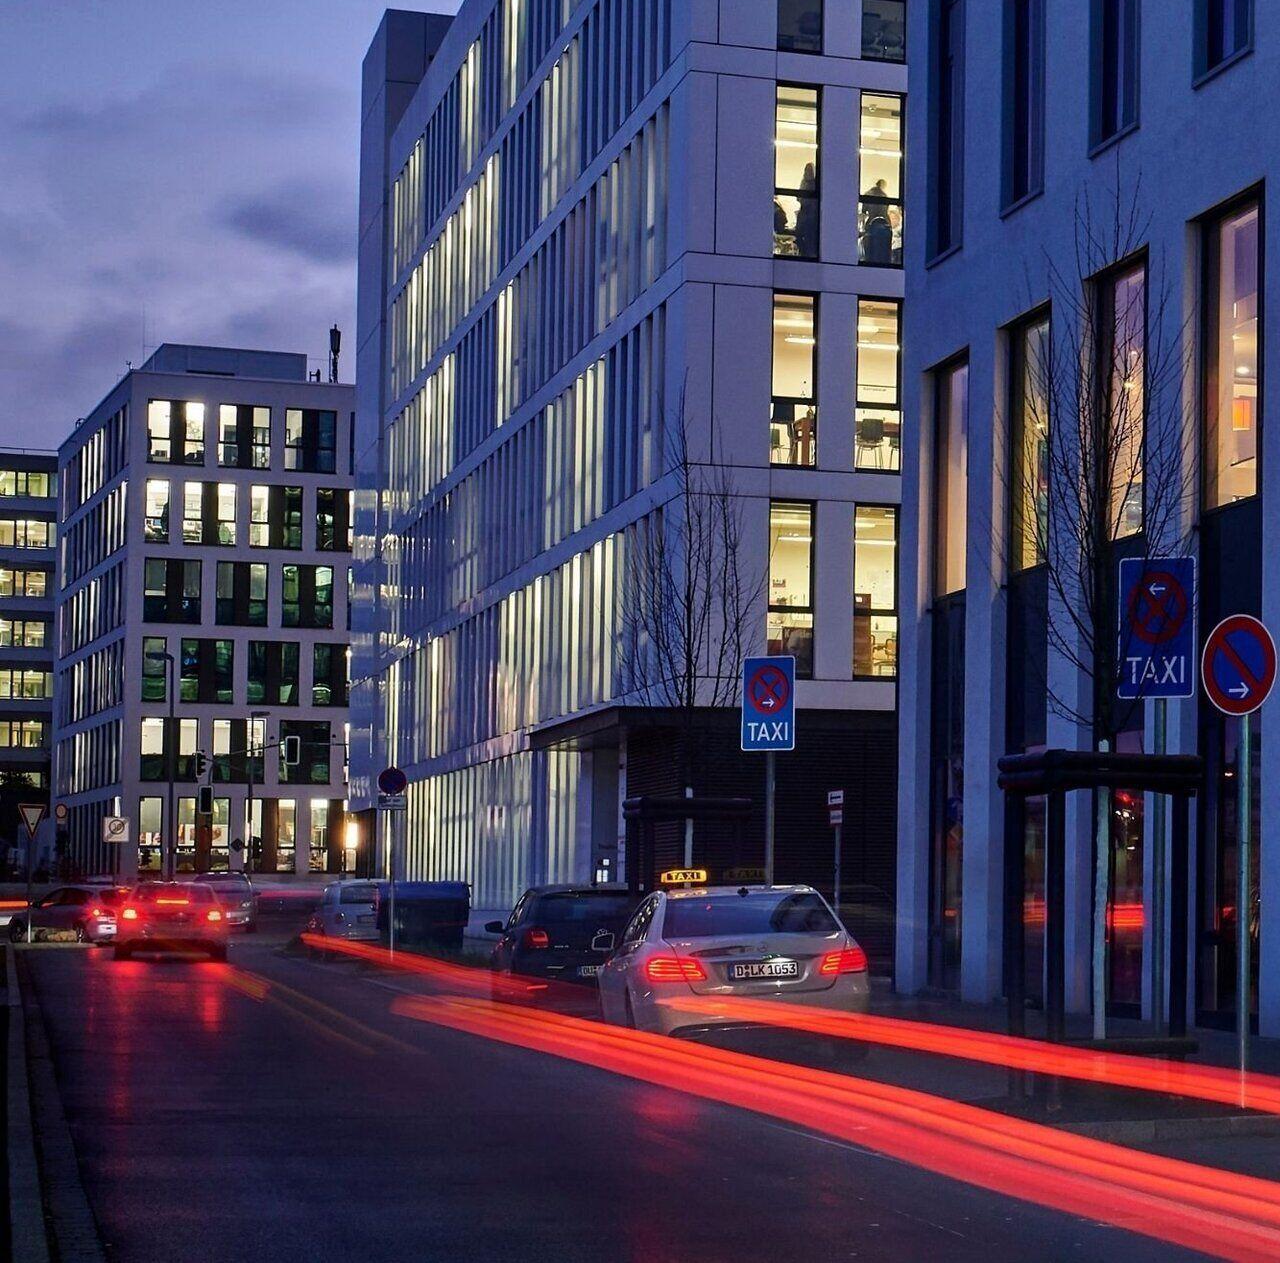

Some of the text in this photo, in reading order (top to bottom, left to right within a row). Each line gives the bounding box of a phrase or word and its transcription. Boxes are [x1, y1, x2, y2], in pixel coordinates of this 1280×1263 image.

[1126, 655, 1186, 685] TAXI
[747, 722, 789, 742] TAXI
[670, 871, 698, 880] TAXI
